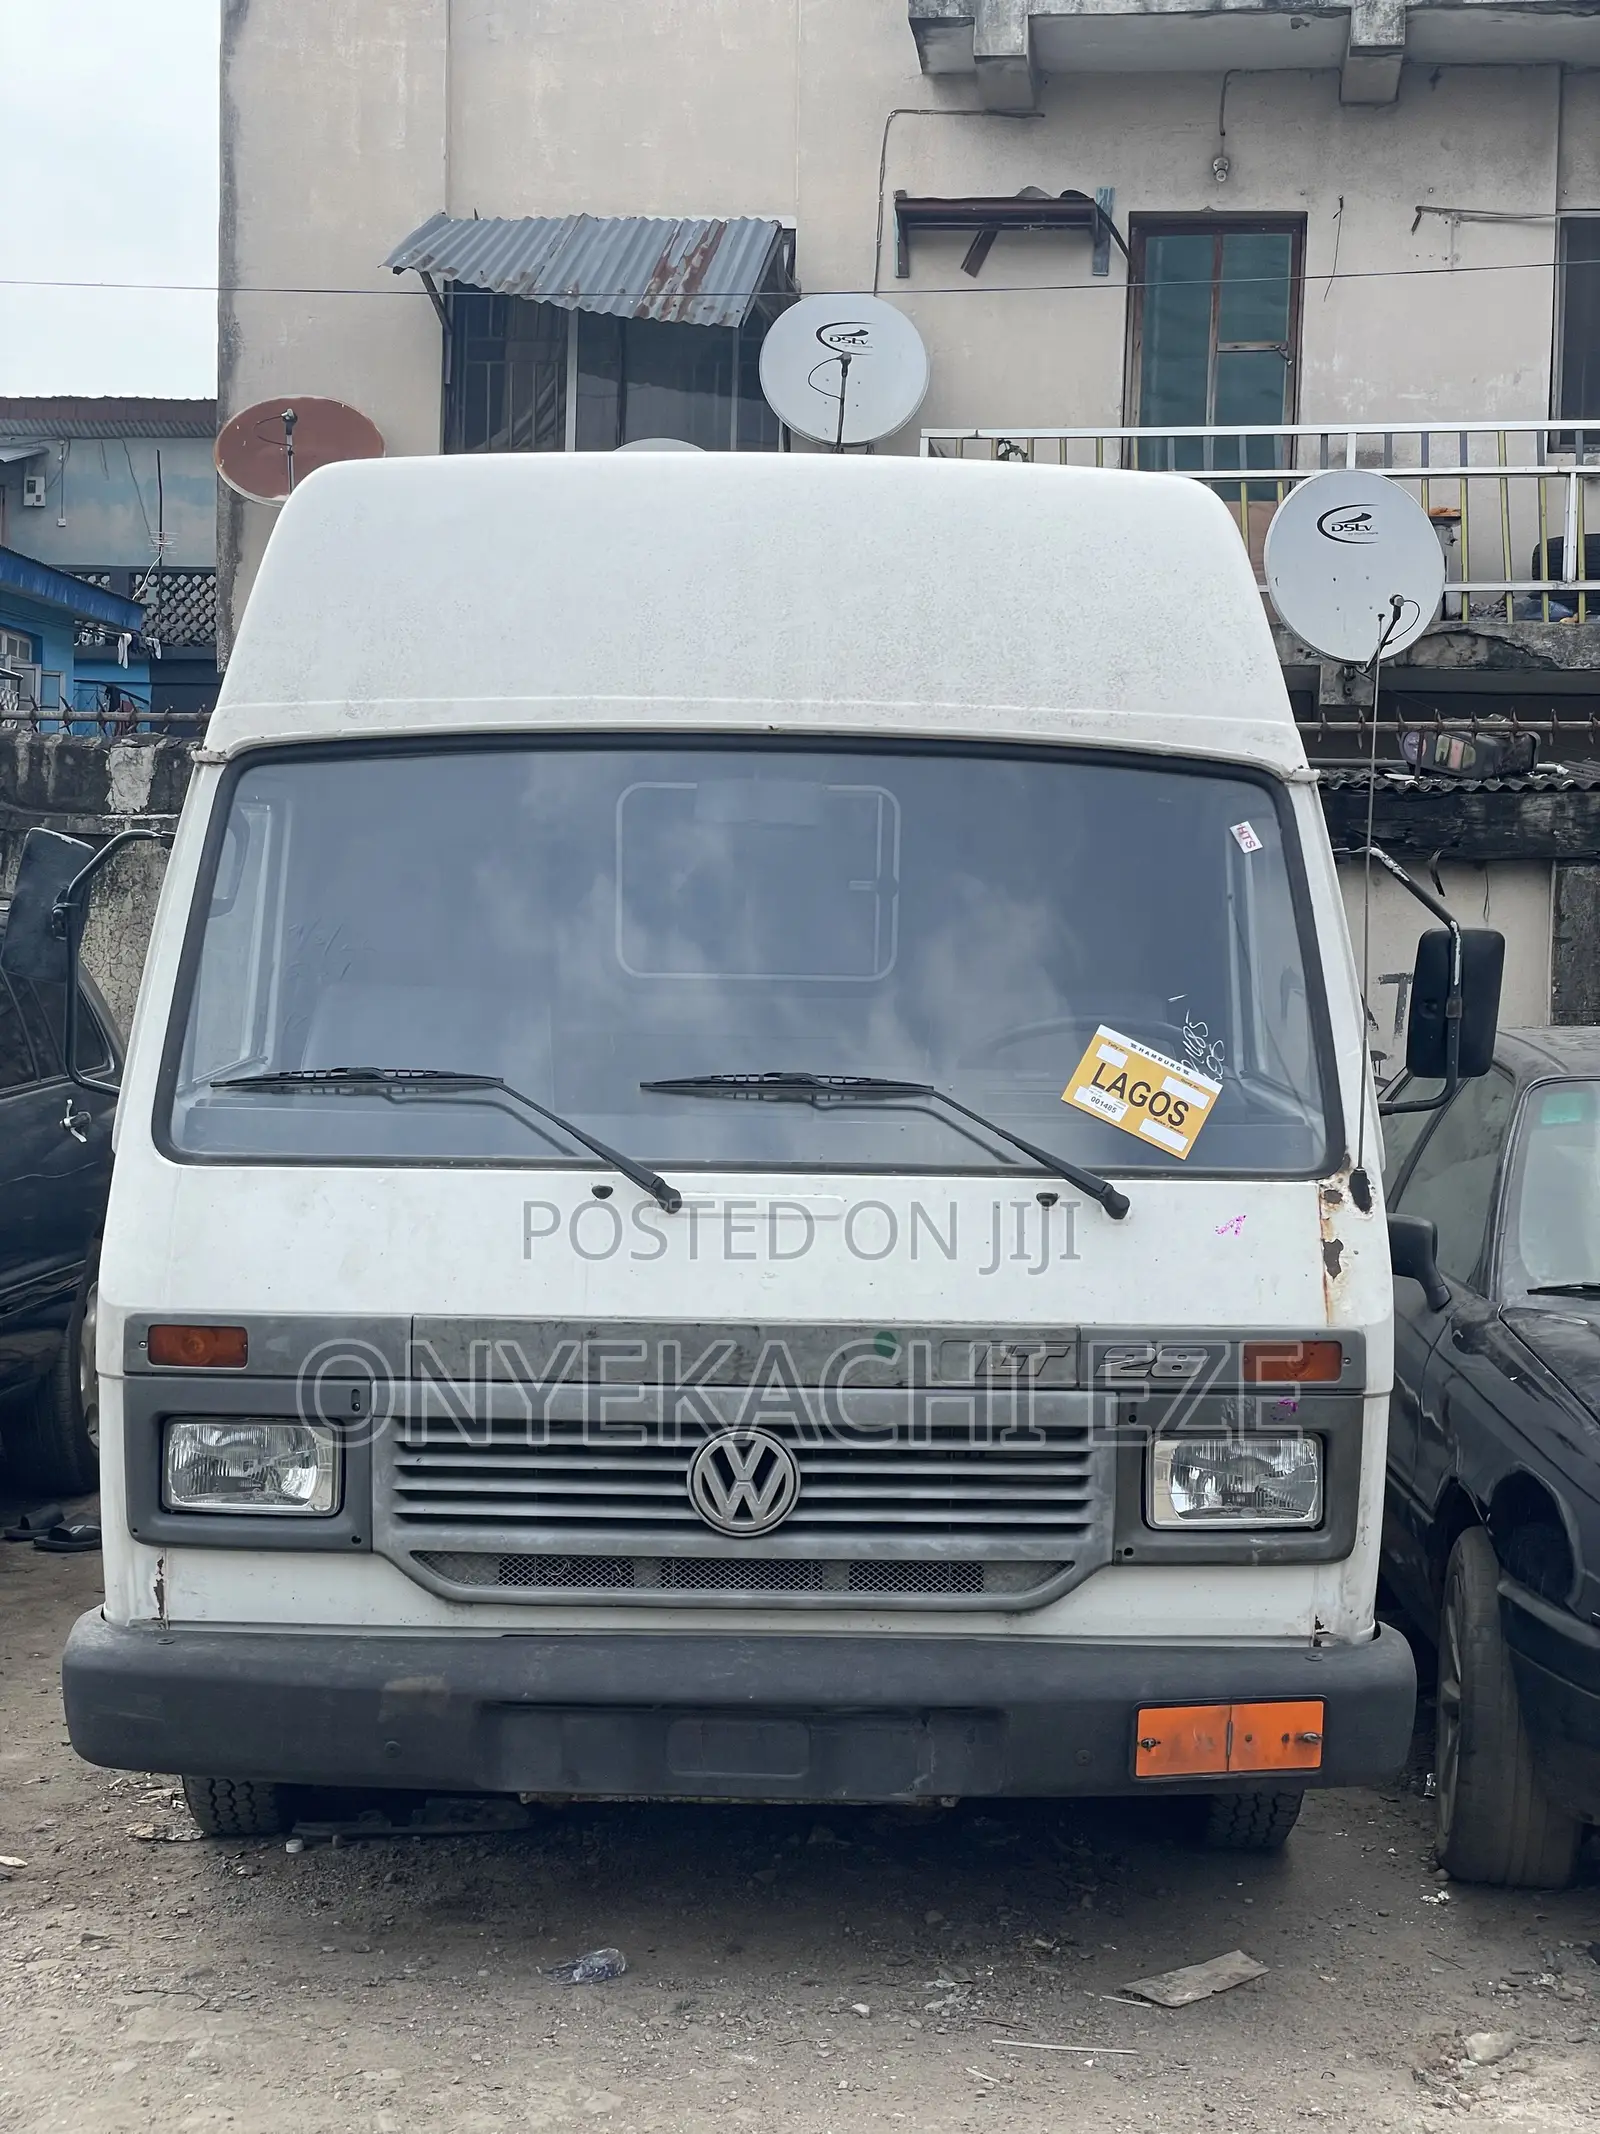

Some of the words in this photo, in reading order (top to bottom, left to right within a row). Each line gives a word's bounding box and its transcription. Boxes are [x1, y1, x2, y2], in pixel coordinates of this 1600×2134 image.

[829, 336, 868, 345] DStv
[1331, 523, 1373, 532] DStv
[1138, 1047, 1181, 1071] HAMBURG
[1091, 1062, 1189, 1127] LAGOS
[1090, 1096, 1117, 1114] 001485
